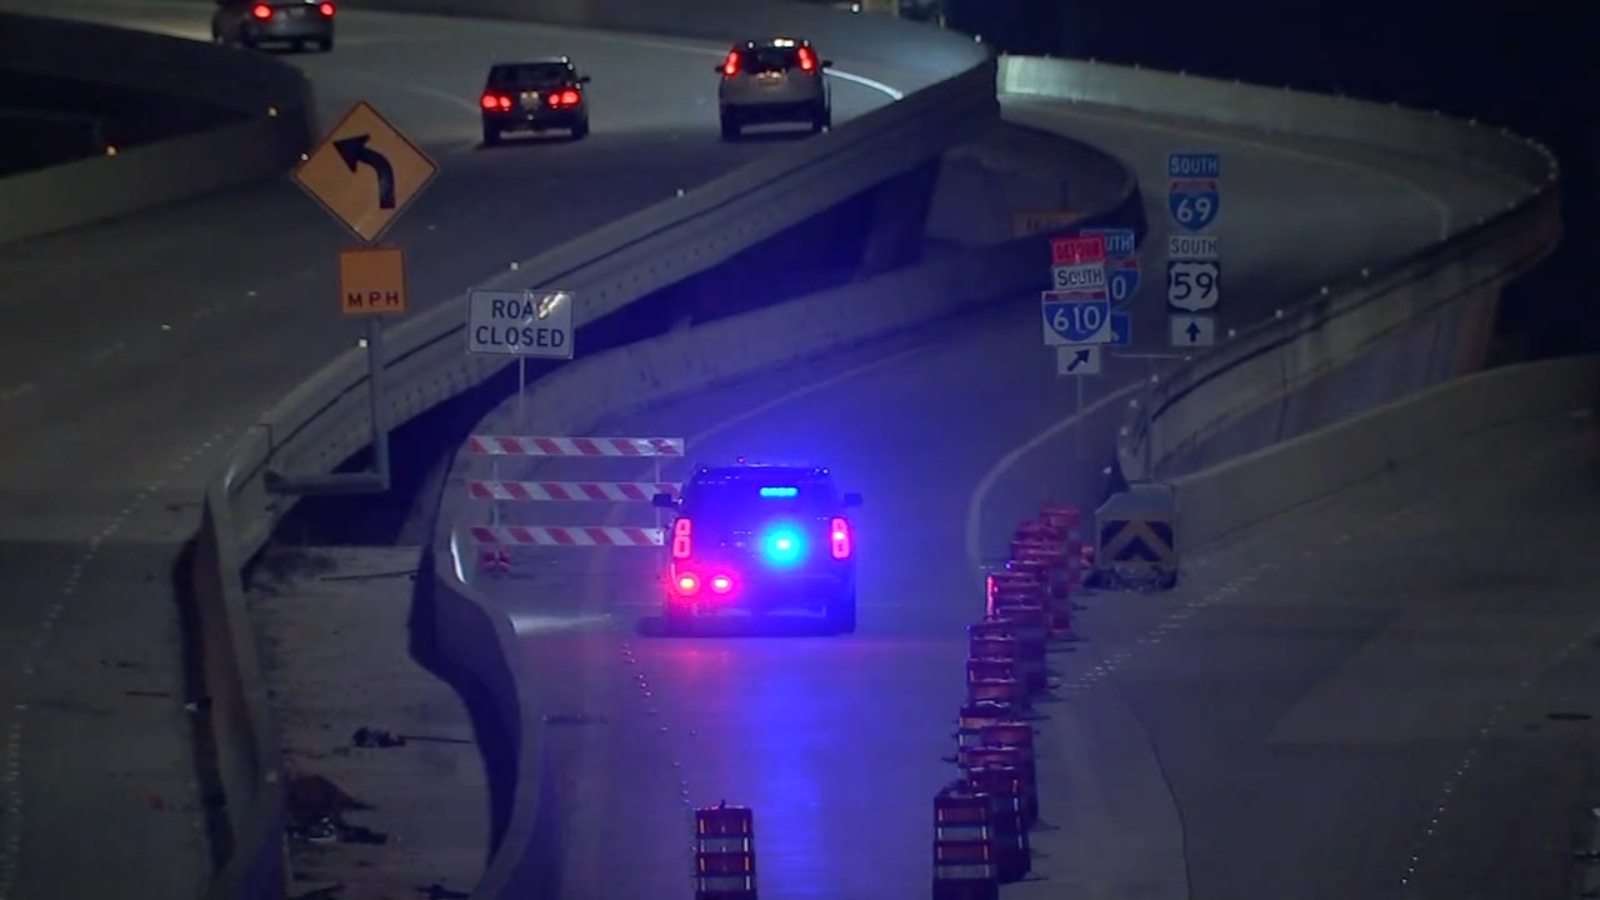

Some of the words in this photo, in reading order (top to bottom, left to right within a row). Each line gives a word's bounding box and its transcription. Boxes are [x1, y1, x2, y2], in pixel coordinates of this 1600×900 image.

[1170, 156, 1218, 174] SOUTH
[1177, 198, 1212, 222] 69
[1170, 238, 1217, 255] SOUTH
[1057, 268, 1102, 286] SOUTH
[1173, 271, 1213, 300] 59
[348, 290, 399, 308] MPH
[491, 299, 551, 319] ROA
[1053, 305, 1101, 331] 610
[475, 325, 565, 348] CLOSED
